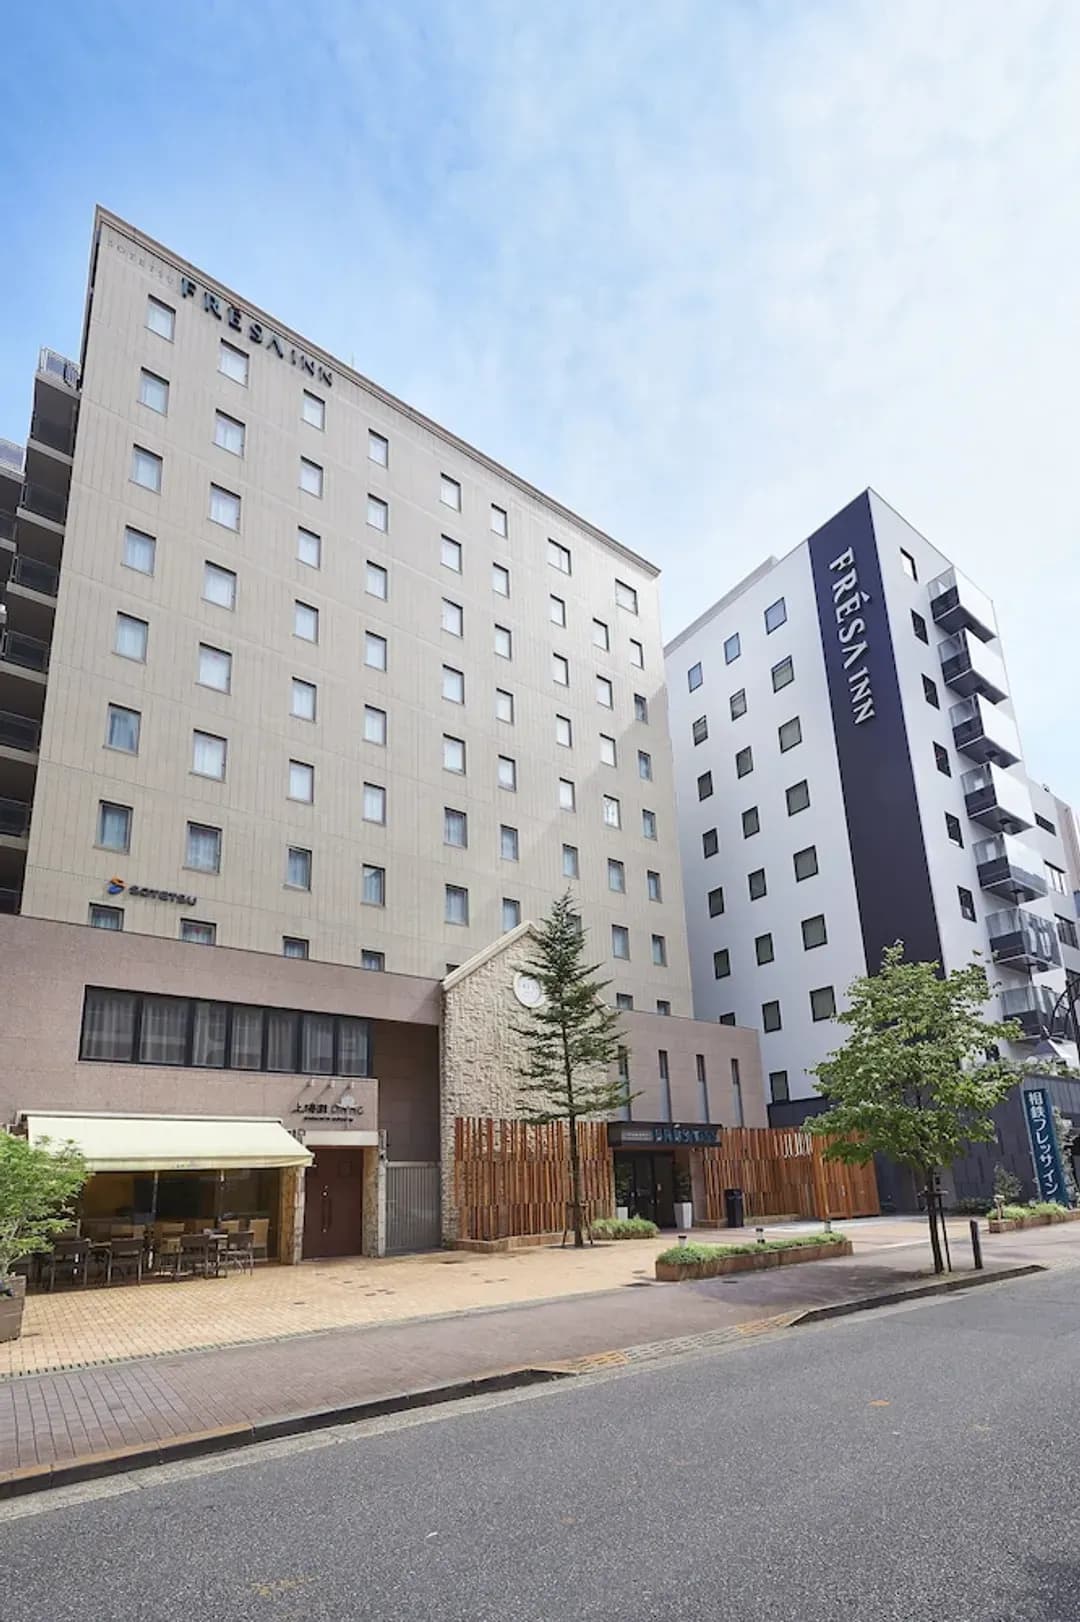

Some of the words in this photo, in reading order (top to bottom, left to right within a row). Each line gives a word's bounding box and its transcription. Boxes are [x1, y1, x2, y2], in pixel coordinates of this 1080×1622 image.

[848, 666, 876, 725] INN
[128, 885, 197, 906] SOTETSU
[1028, 1091, 1059, 1196] 相鉄フレッサイン
